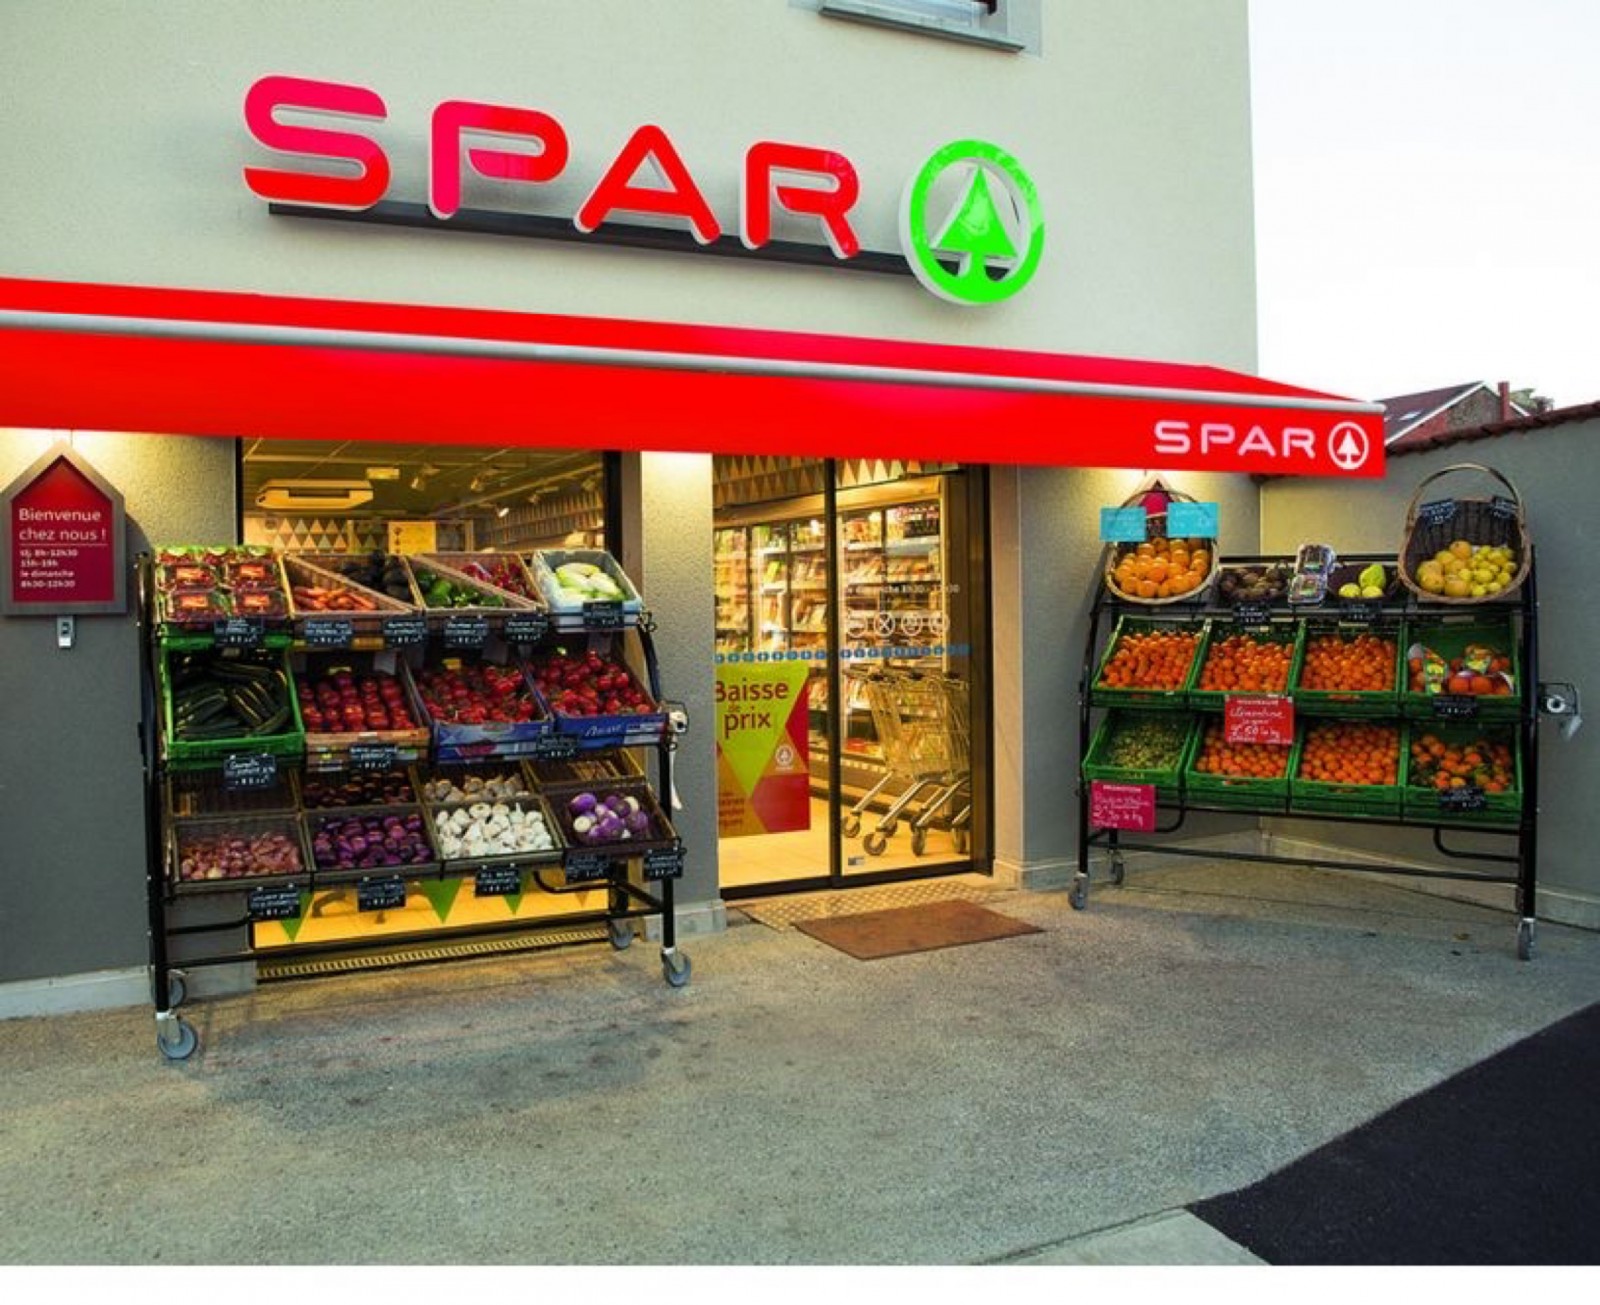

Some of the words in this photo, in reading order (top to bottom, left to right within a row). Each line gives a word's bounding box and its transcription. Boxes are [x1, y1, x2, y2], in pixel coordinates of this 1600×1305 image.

[243, 75, 861, 260] SPAR
[1154, 420, 1316, 459] SPAR
[19, 507, 101, 521] Bienvenue
[19, 528, 55, 541] chez
[60, 530, 97, 541] nous
[715, 677, 789, 703] Baisse
[724, 706, 771, 739] prix
